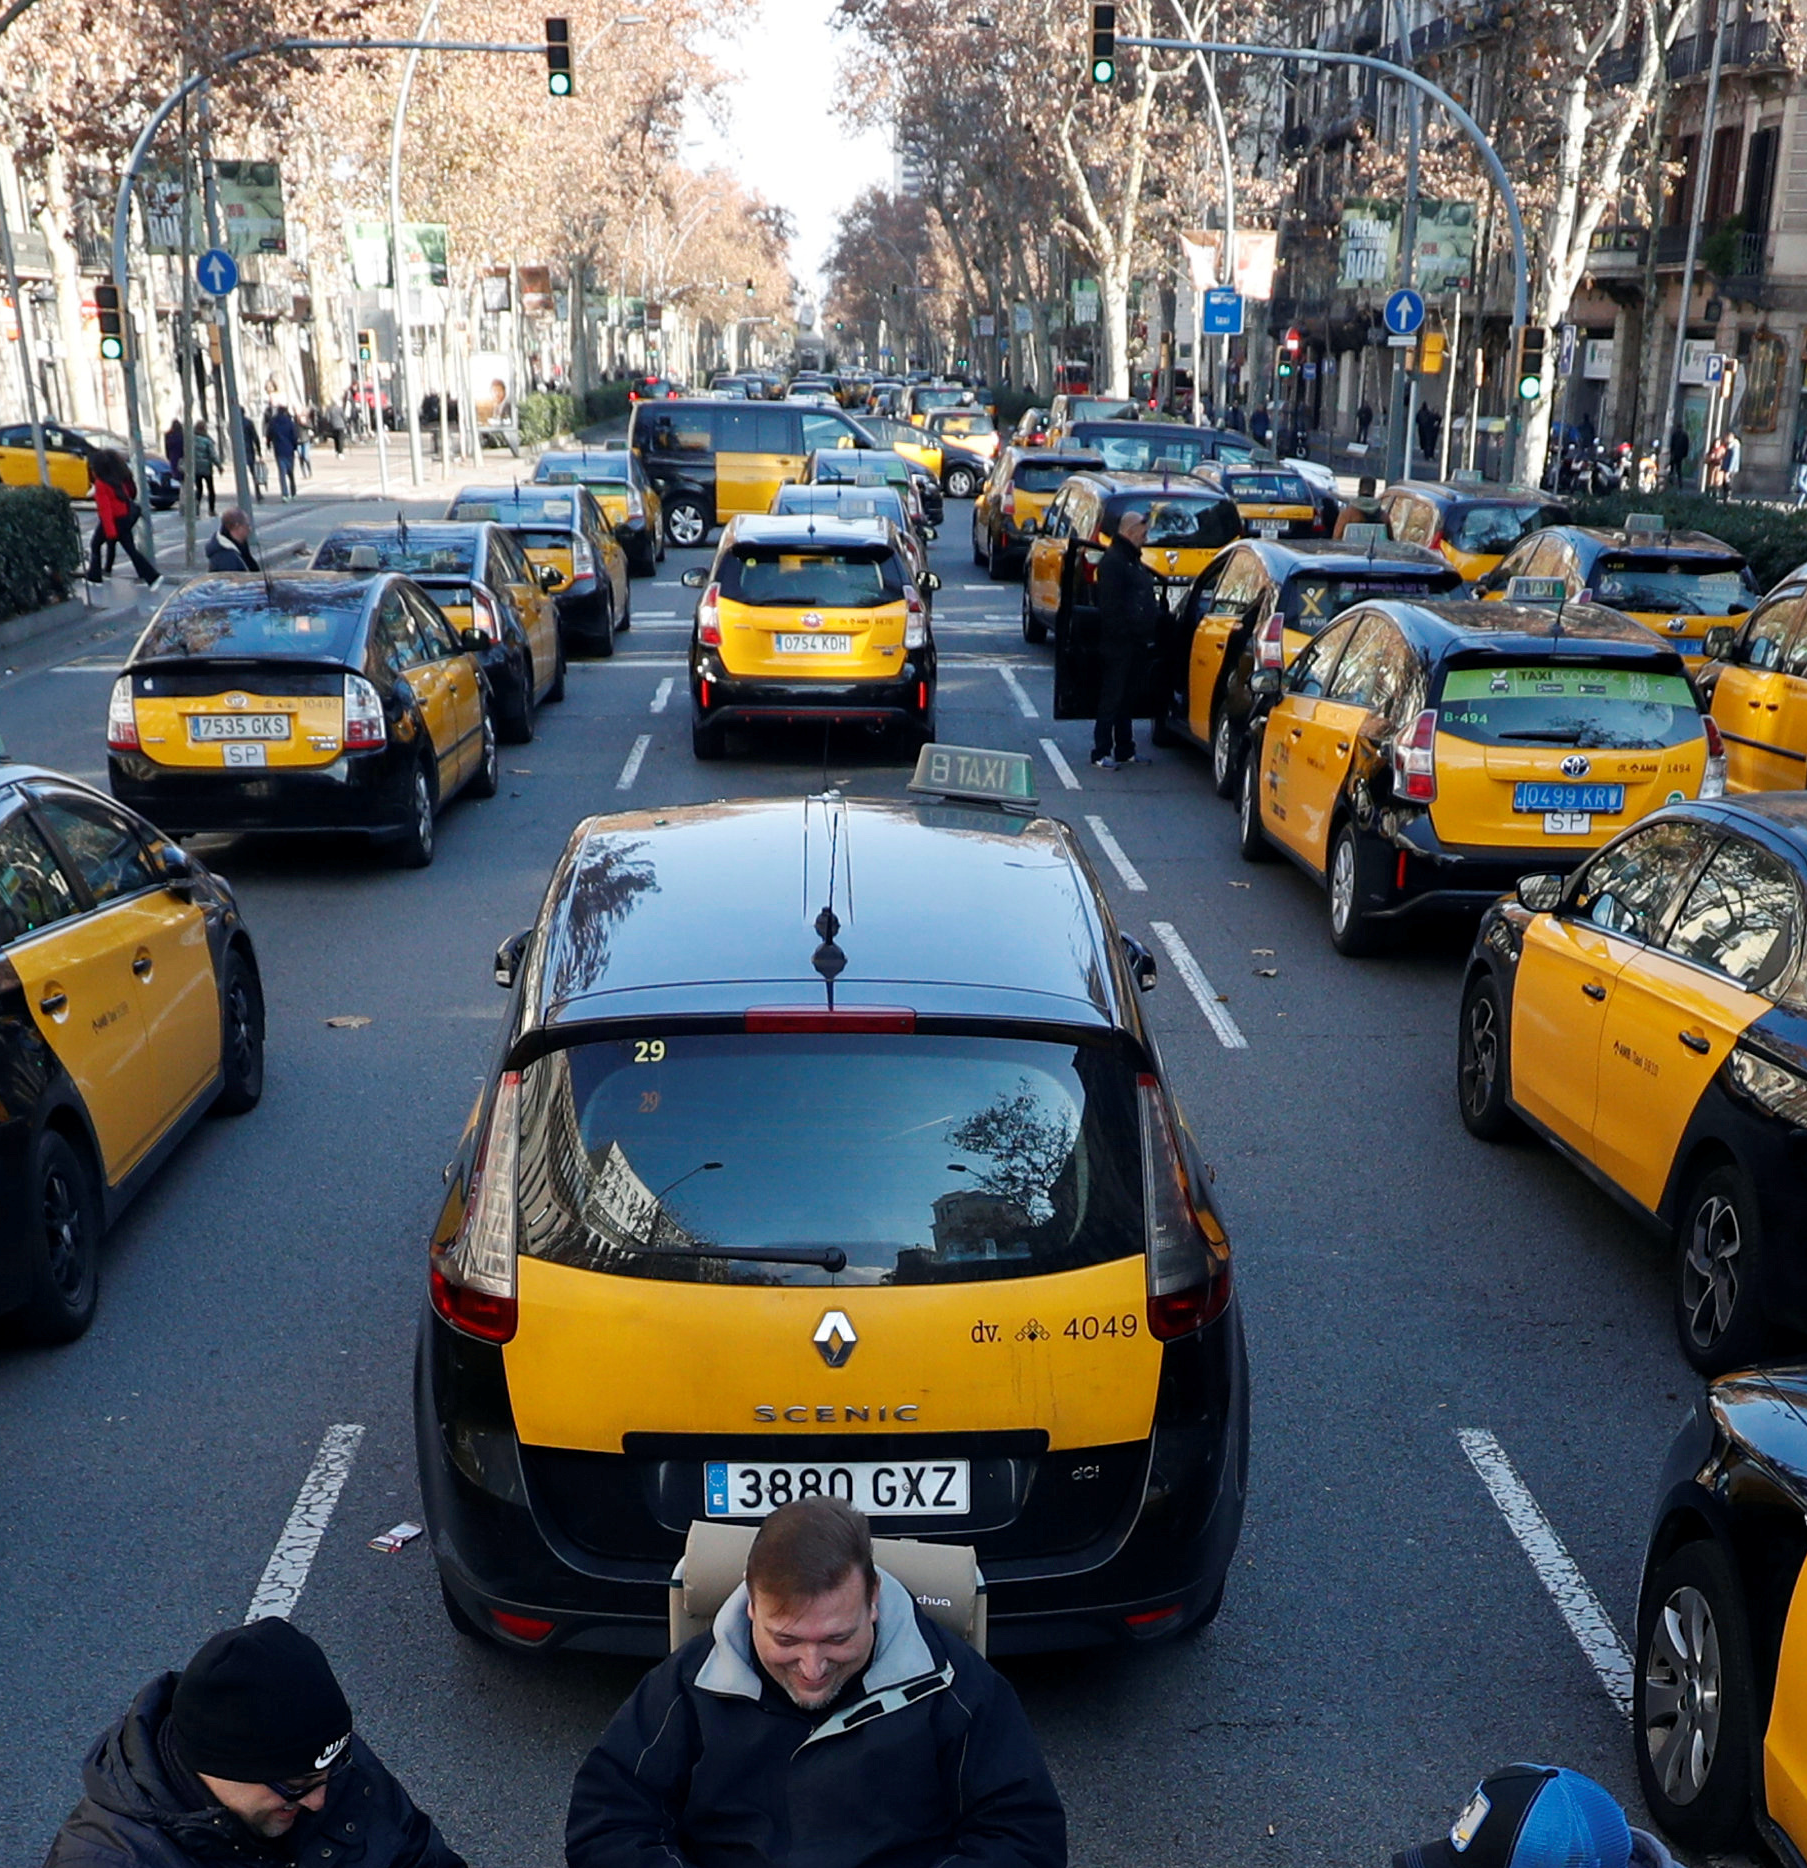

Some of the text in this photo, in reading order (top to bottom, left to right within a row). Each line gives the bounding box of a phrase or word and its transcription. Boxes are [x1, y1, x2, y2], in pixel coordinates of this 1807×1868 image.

[1348, 218, 1392, 238] PREMIS
[1346, 249, 1387, 280] ROIG
[1564, 330, 1572, 348] P
[1708, 358, 1720, 375] P
[1529, 582, 1554, 597] TAXI
[783, 635, 847, 651] 0754 KDH
[201, 715, 285, 737] 7535 GKS
[229, 746, 258, 764] SP
[957, 756, 1007, 788] TAXI
[1667, 763, 1691, 774] 1494
[1528, 785, 1621, 807] 0499 KRW
[1551, 812, 1585, 831] SP
[633, 1040, 665, 1063] 29
[971, 1315, 1137, 1343] dv. 4049
[754, 1404, 919, 1422] SCENIC
[713, 1466, 957, 1509] E 3880 GXZ
[916, 1595, 951, 1608] chua
